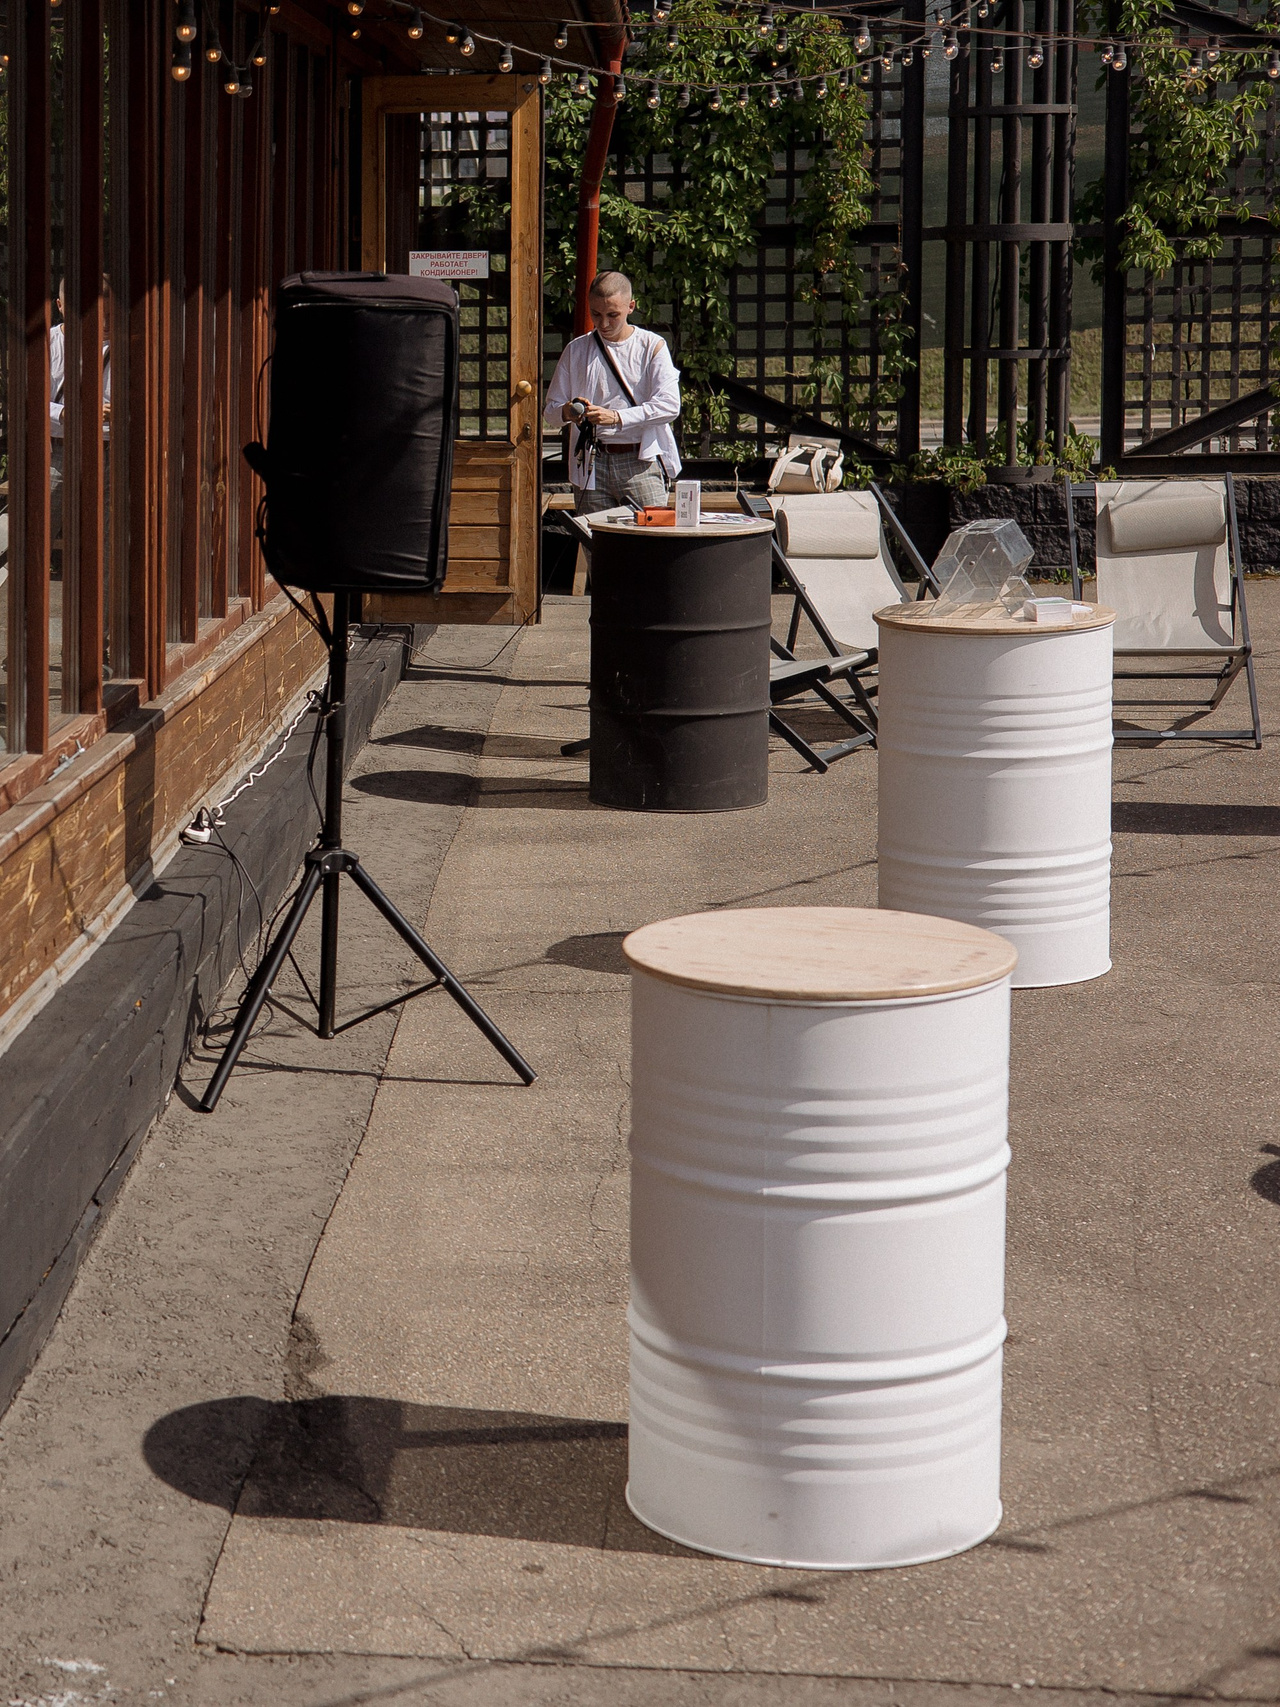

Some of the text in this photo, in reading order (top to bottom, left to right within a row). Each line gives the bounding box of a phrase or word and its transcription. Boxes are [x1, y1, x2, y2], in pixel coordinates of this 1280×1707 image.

[411, 252, 487, 260] ЗАКРЫВАЙТЕ ДВЕРИ
[420, 269, 478, 277] КОНДИЦИОНЕР!
